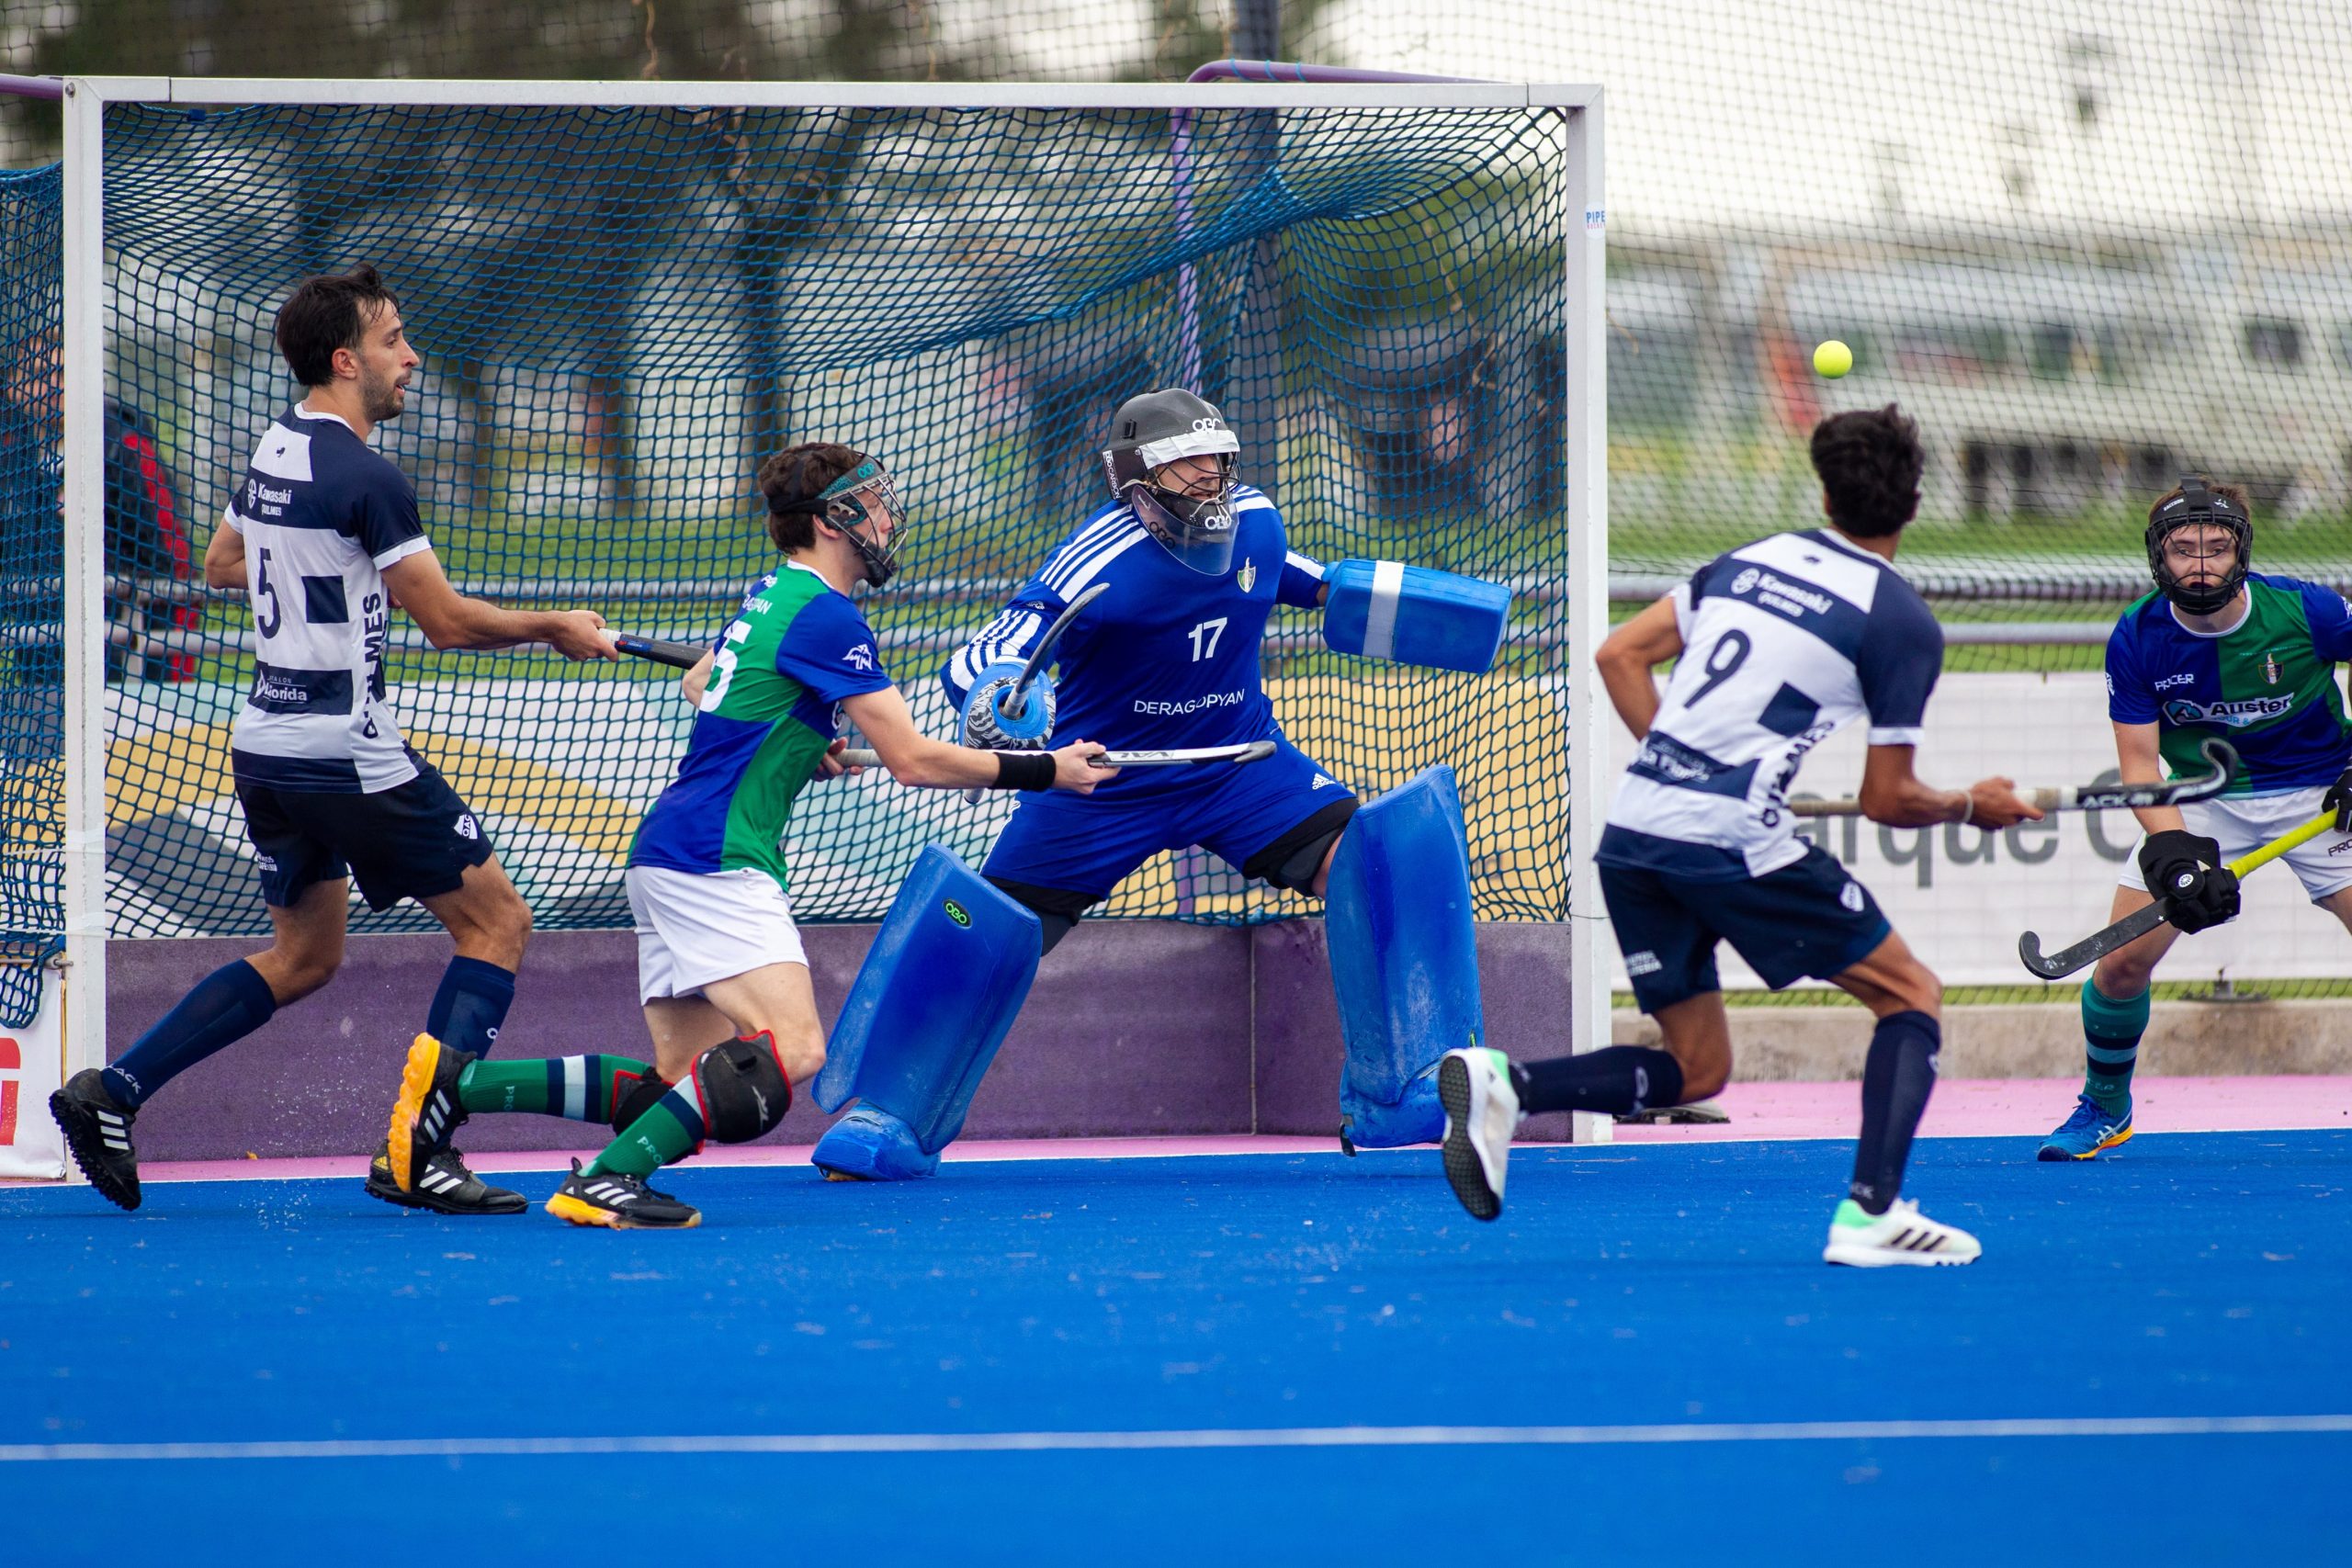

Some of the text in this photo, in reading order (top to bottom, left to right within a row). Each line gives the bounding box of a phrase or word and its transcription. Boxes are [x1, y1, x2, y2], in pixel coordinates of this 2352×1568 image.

[1587, 210, 1605, 223] PIPE
[258, 482, 292, 504] Kawasaki
[1149, 521, 1176, 549] OBO
[257, 547, 282, 639] 5
[1757, 572, 1834, 615] Kawasaki
[1188, 616, 1228, 662] 17
[1684, 628, 1751, 710] 9
[1134, 688, 1245, 716] DERAGOPYAN
[2211, 696, 2293, 716] Auster
[945, 902, 967, 924] OBO
